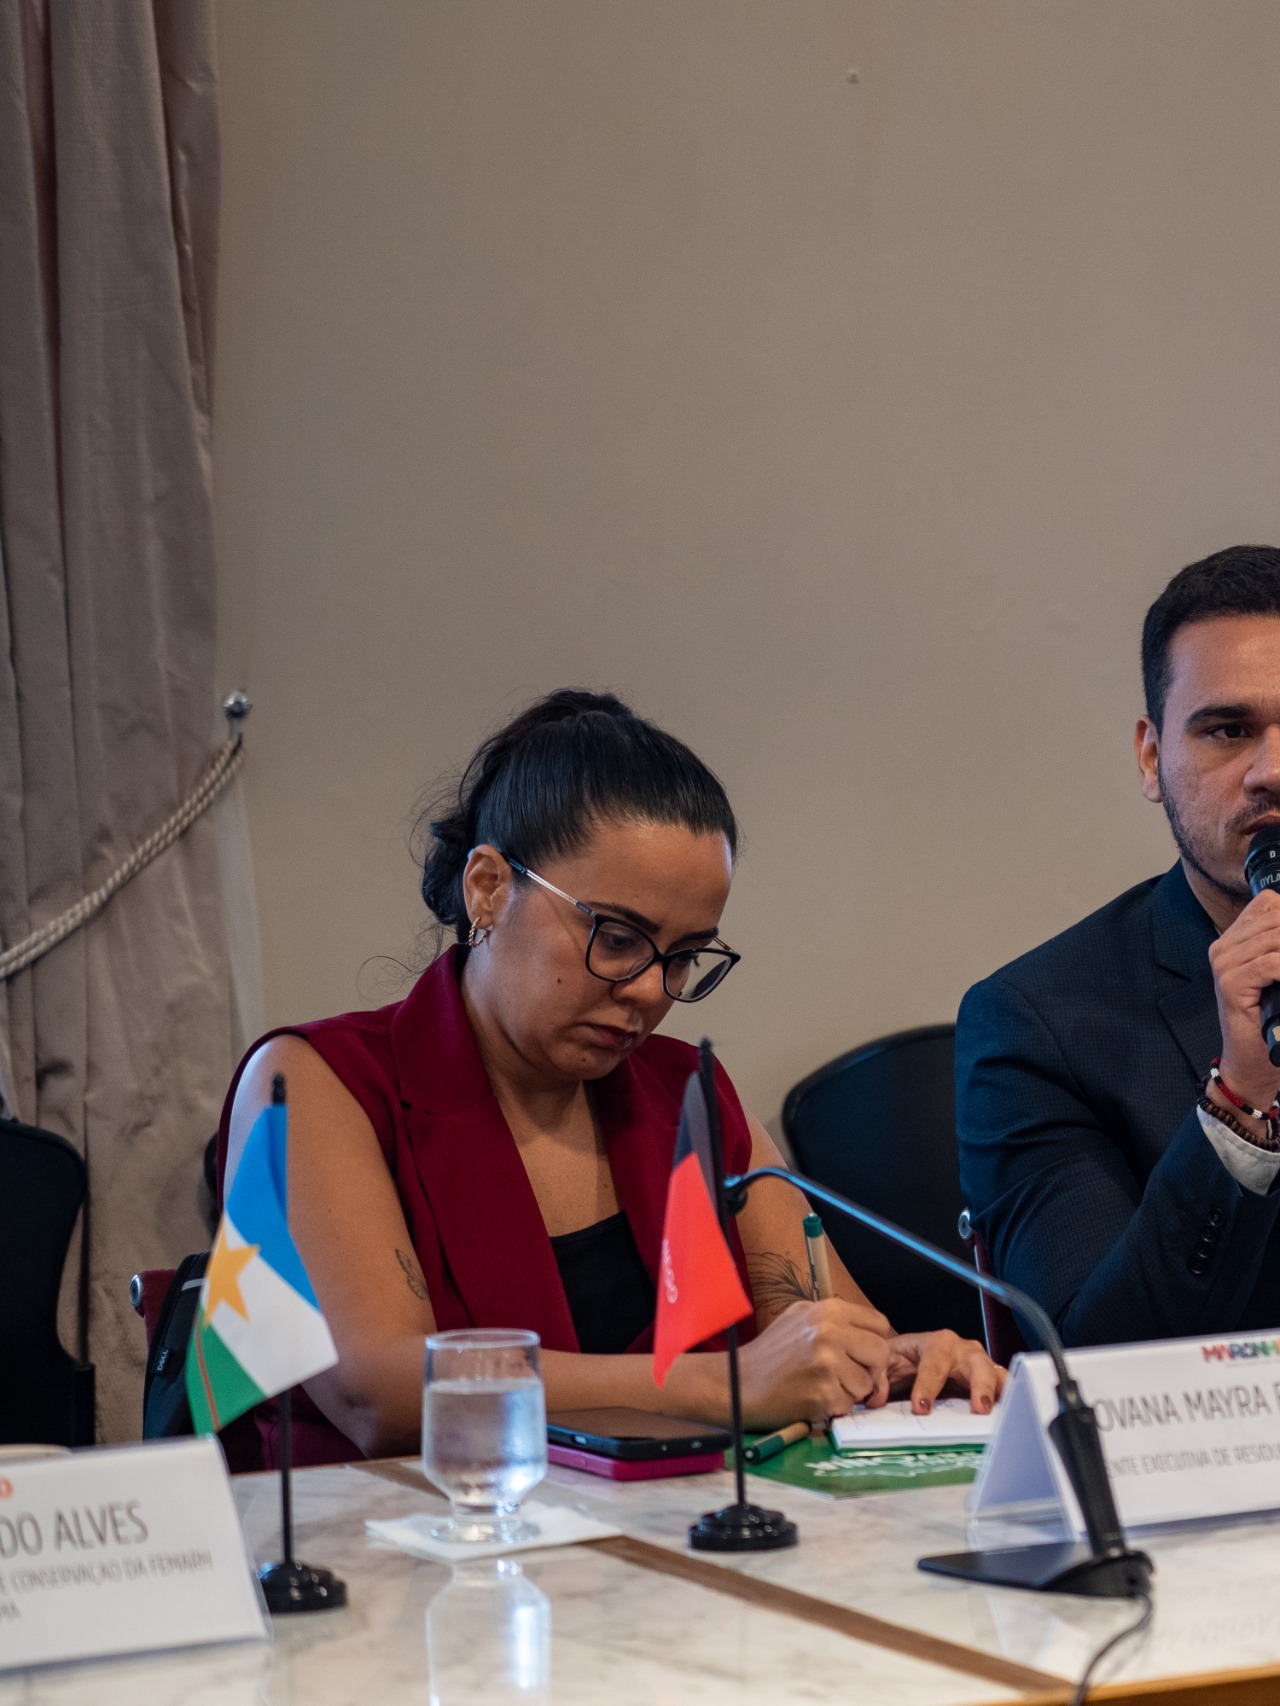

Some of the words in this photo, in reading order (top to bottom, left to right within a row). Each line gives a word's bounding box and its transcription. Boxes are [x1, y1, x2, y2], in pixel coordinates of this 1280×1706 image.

[1183, 1384, 1274, 1422] MAYRA
[1141, 1449, 1212, 1475] EXECUTIVA
[1213, 1448, 1236, 1467] DE
[54, 1500, 149, 1552] ALVES
